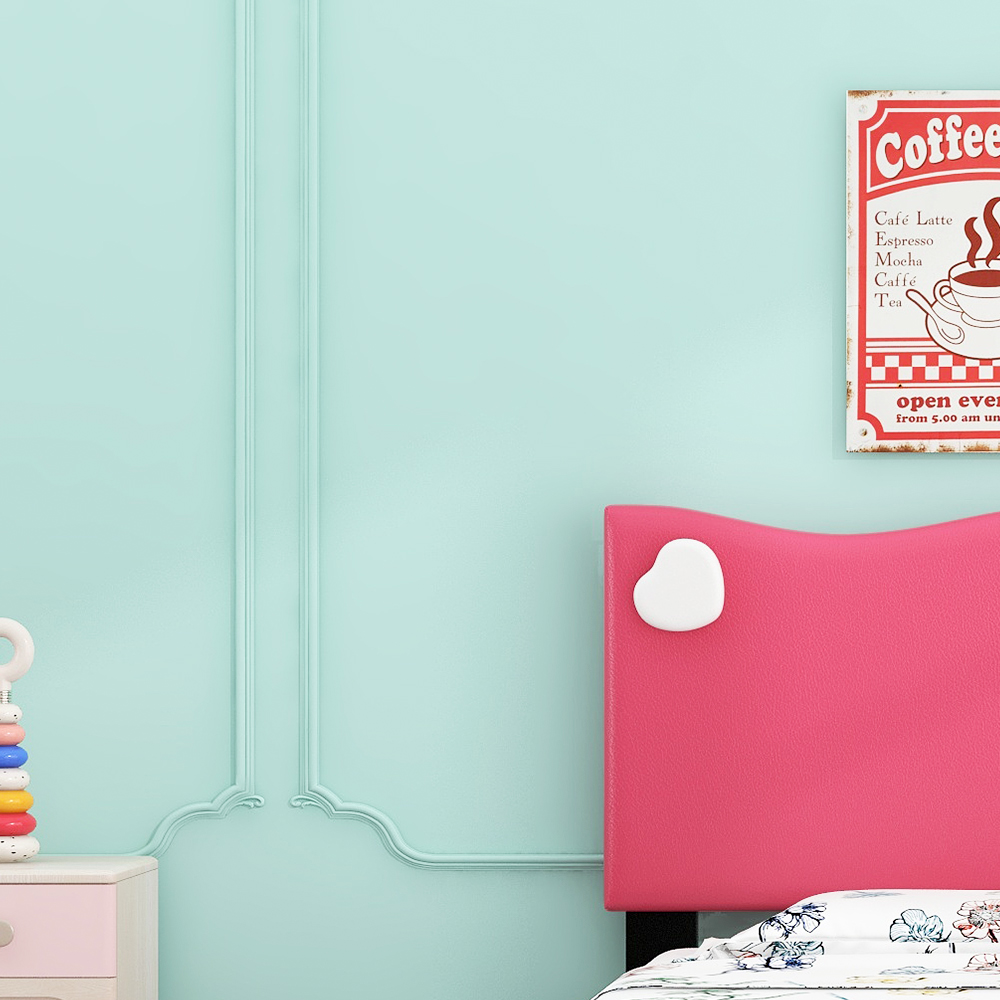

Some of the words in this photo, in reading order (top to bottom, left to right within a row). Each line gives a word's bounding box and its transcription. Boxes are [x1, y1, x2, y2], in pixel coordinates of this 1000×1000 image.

[874, 211, 909, 226] Café
[916, 211, 953, 226] Latte
[875, 231, 934, 249] Espresso
[875, 252, 923, 267] Mocha
[874, 271, 917, 287] Caffé
[874, 293, 903, 308] Tea
[896, 396, 951, 412] open
[896, 414, 928, 423] from
[931, 414, 958, 423] 5.00
